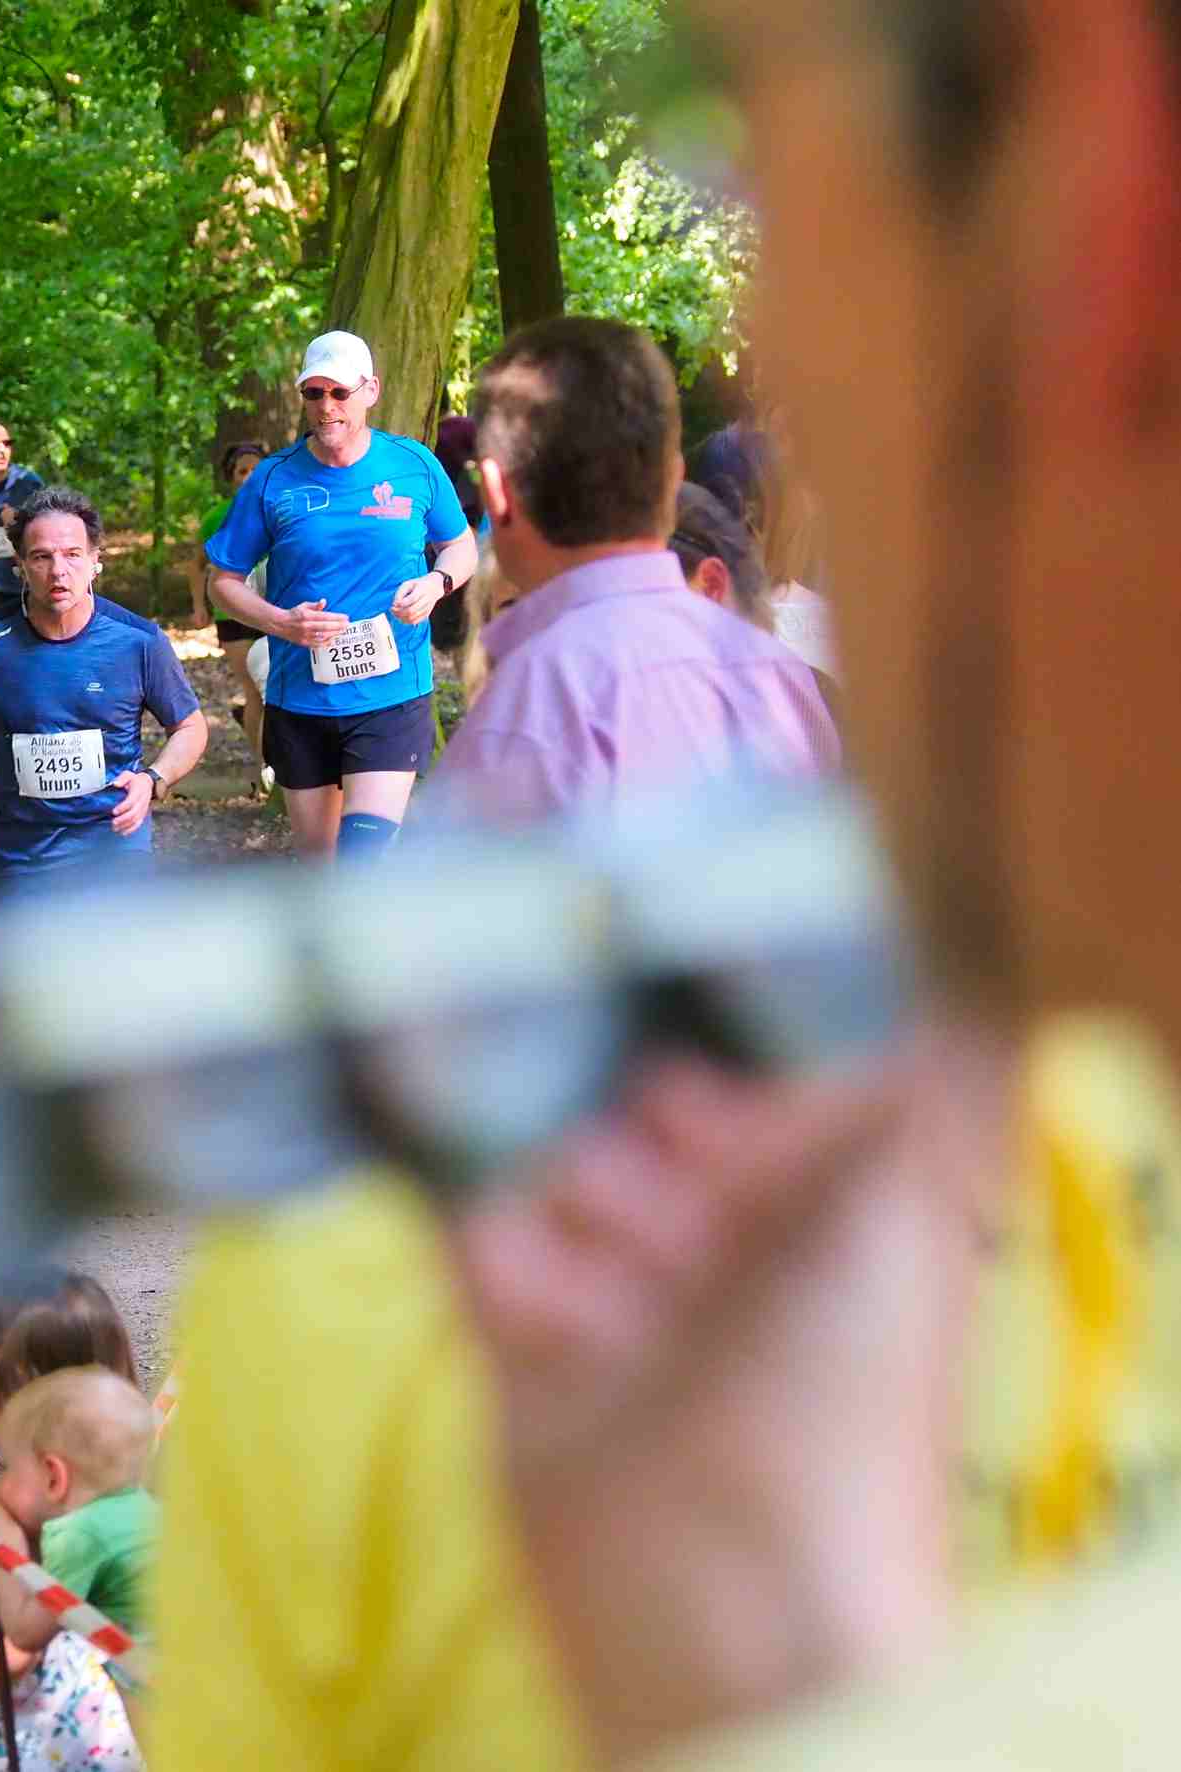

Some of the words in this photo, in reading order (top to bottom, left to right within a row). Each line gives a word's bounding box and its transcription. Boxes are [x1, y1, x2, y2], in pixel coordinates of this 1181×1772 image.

[329, 641, 376, 663] 2558
[335, 661, 376, 678] bruns
[30, 737, 67, 746] Allianz
[35, 756, 83, 774] 2495
[39, 775, 81, 792] bruns
